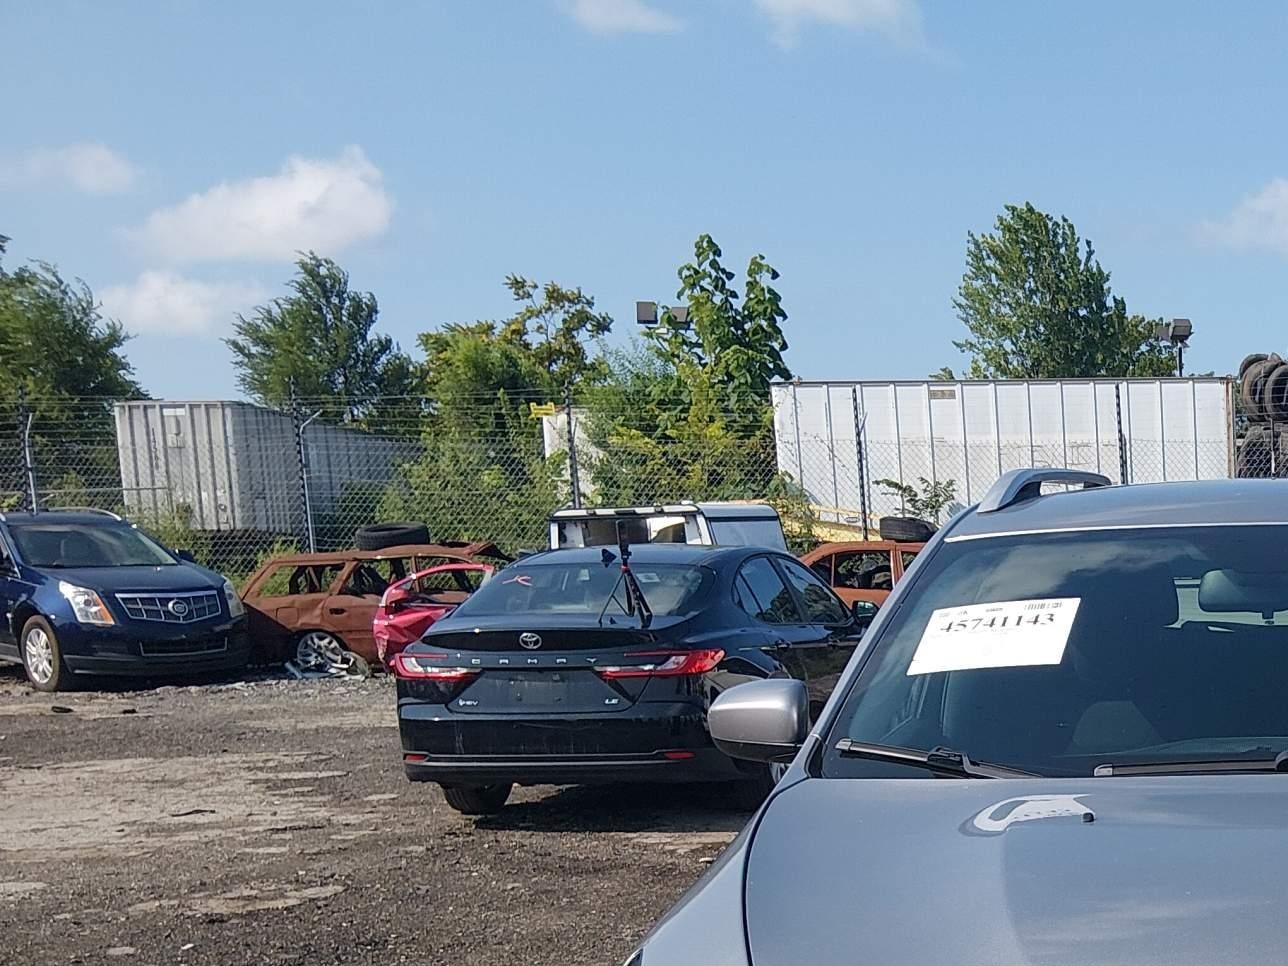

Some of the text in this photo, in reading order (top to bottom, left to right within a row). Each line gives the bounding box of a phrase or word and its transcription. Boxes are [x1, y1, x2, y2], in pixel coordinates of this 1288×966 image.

[939, 612, 1056, 632] 45741143
[471, 657, 597, 665] CAMRY
[604, 697, 619, 705] LE
